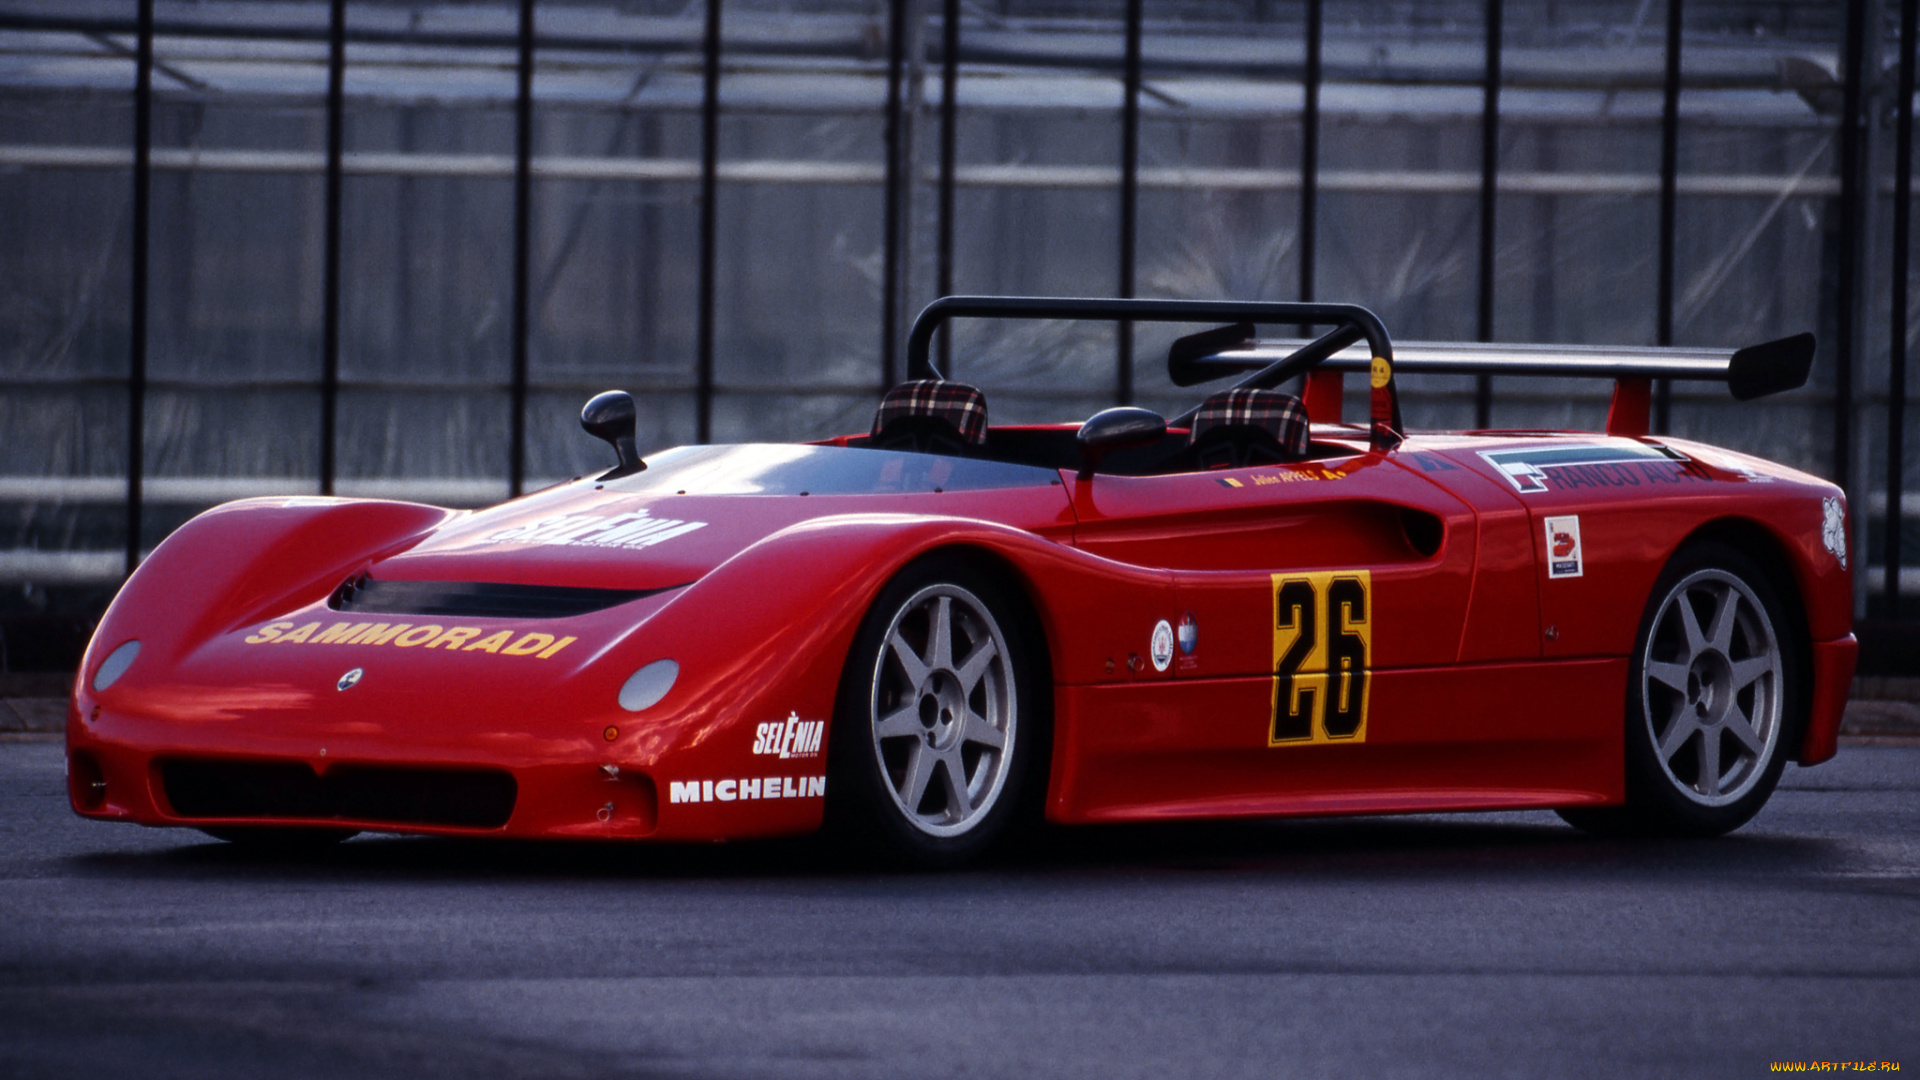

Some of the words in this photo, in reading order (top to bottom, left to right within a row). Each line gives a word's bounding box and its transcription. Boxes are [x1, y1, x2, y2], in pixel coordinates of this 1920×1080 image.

[244, 621, 578, 659] SAMMORADI
[1272, 575, 1368, 743] 26
[669, 776, 826, 804] MICHELIN
